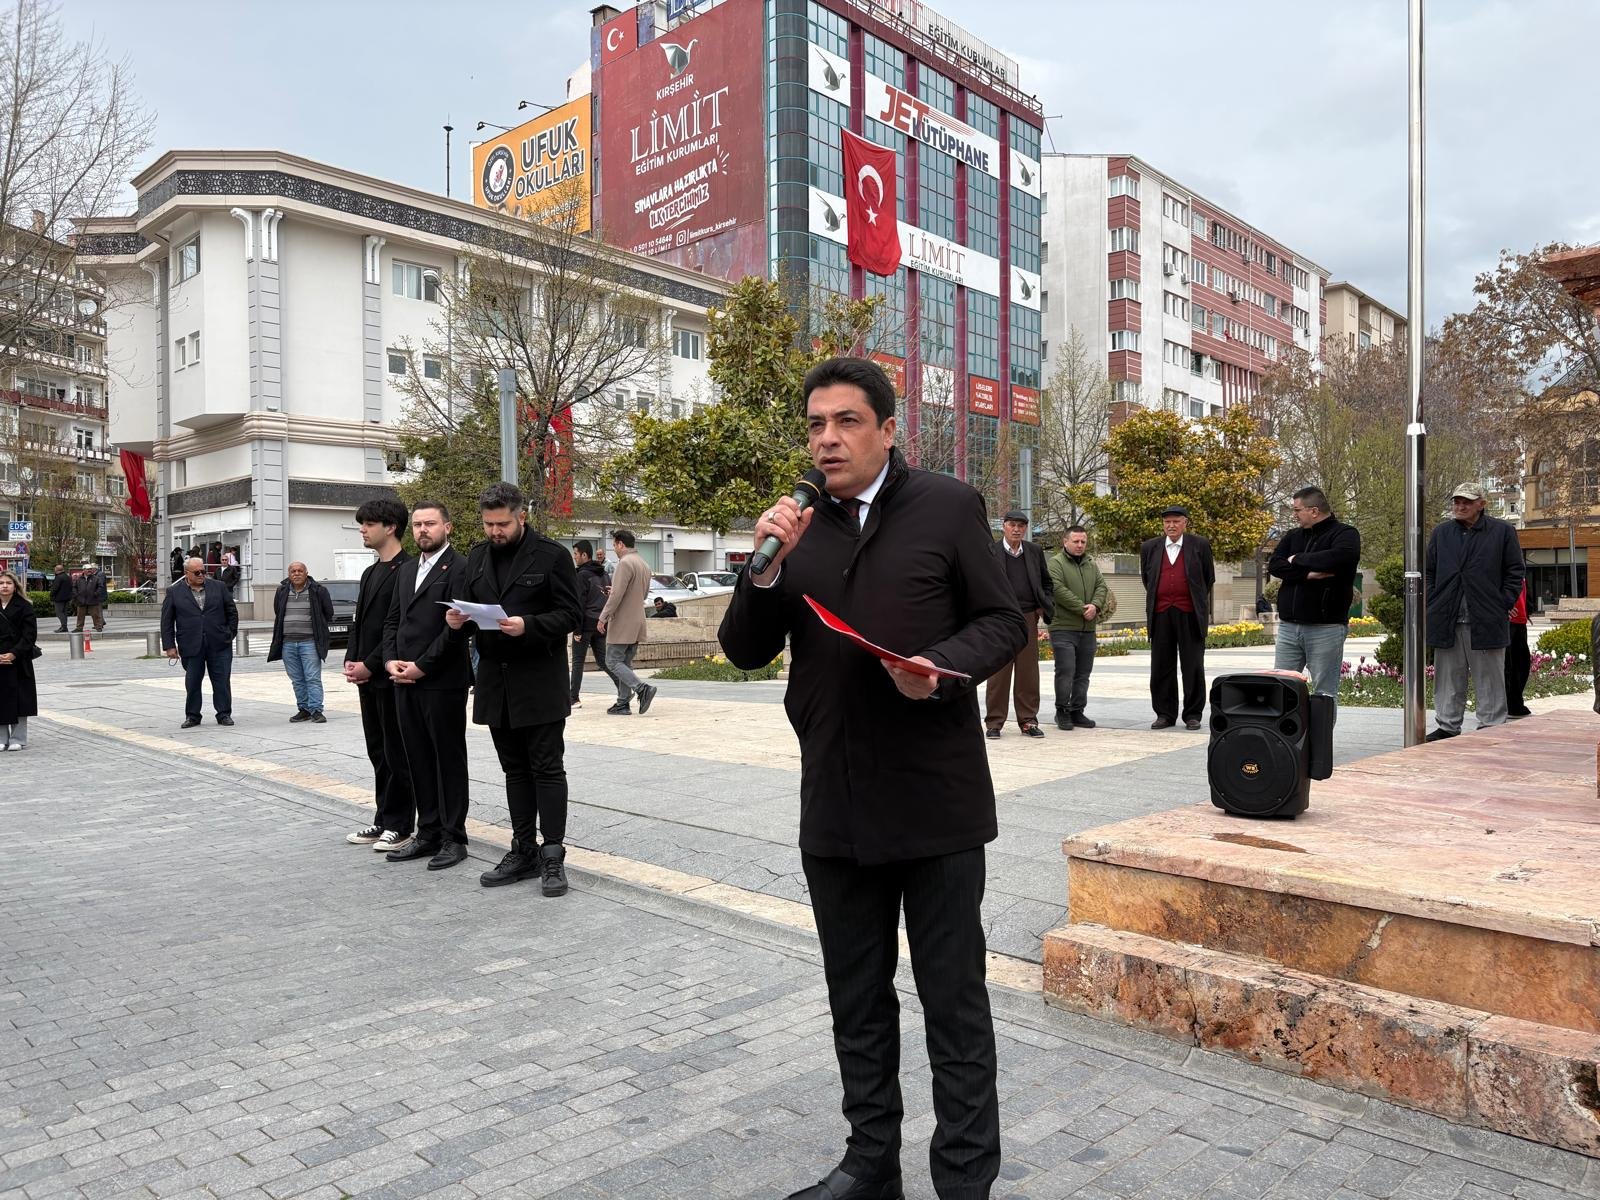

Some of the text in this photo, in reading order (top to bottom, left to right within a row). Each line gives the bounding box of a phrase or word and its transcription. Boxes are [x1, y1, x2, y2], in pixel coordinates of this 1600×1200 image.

[928, 23, 959, 52] EĞİTİM
[656, 74, 694, 101] KIRŞEHİR
[630, 86, 729, 163] LİMİT
[880, 84, 930, 136] JET
[521, 116, 578, 172] UFUK
[635, 132, 719, 176] EĞİTİM KURUMLARI
[912, 116, 989, 173] KÜTÜPHANE
[515, 149, 585, 200] OKULLARI
[635, 158, 718, 213] SINAVLARA HAZIRLIKTA
[649, 206, 665, 229] İLK
[909, 232, 966, 274] LİMİT
[910, 260, 964, 284] EĞİTİM KURUMLARI
[10, 522, 24, 530] EDS
